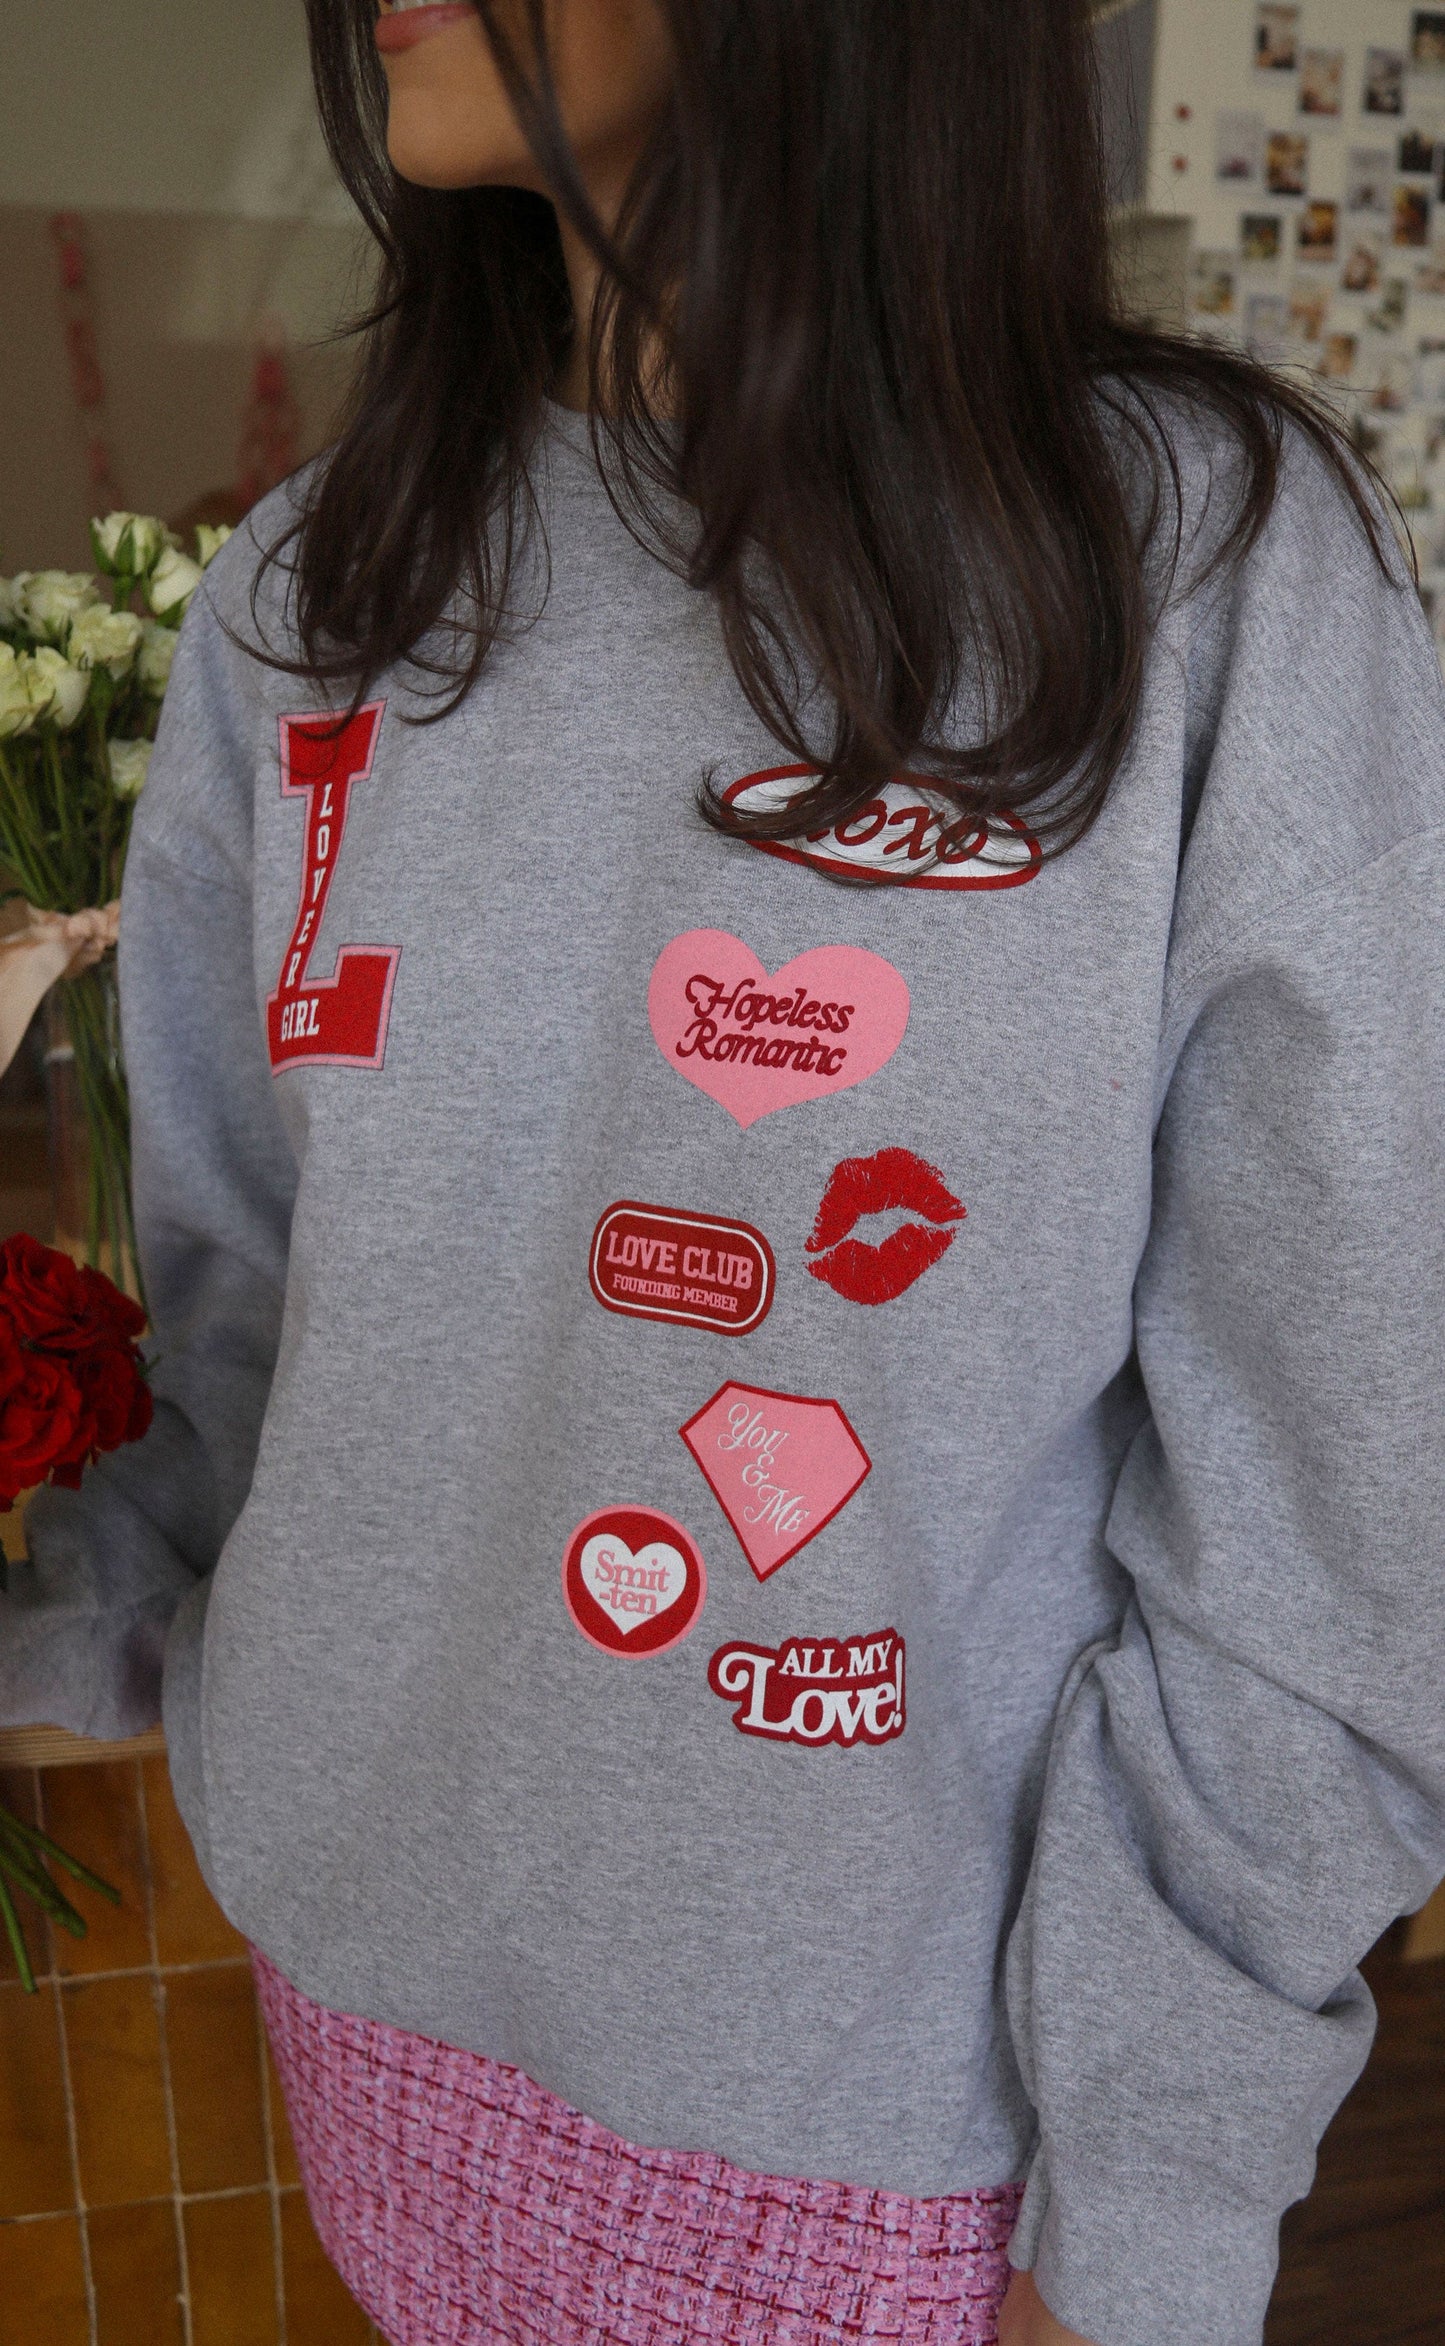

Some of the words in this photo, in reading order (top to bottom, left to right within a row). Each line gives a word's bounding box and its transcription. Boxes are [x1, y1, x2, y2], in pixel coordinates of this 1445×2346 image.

[787, 796, 988, 864] oxo
[285, 783, 333, 988] LOVER
[281, 998, 320, 1042] GIRL
[685, 974, 855, 1033] Hopeless
[676, 1018, 847, 1076] Romantic
[606, 1231, 678, 1274] LOVE
[682, 1246, 754, 1290] CLUB
[613, 1273, 681, 1300] FOUNDING
[683, 1287, 738, 1313] MEMBER
[741, 1451, 775, 1487] &
[594, 1549, 671, 1592] Smit
[599, 1584, 658, 1615] -ten
[778, 1648, 844, 1679] ALL
[845, 1638, 893, 1678] MY
